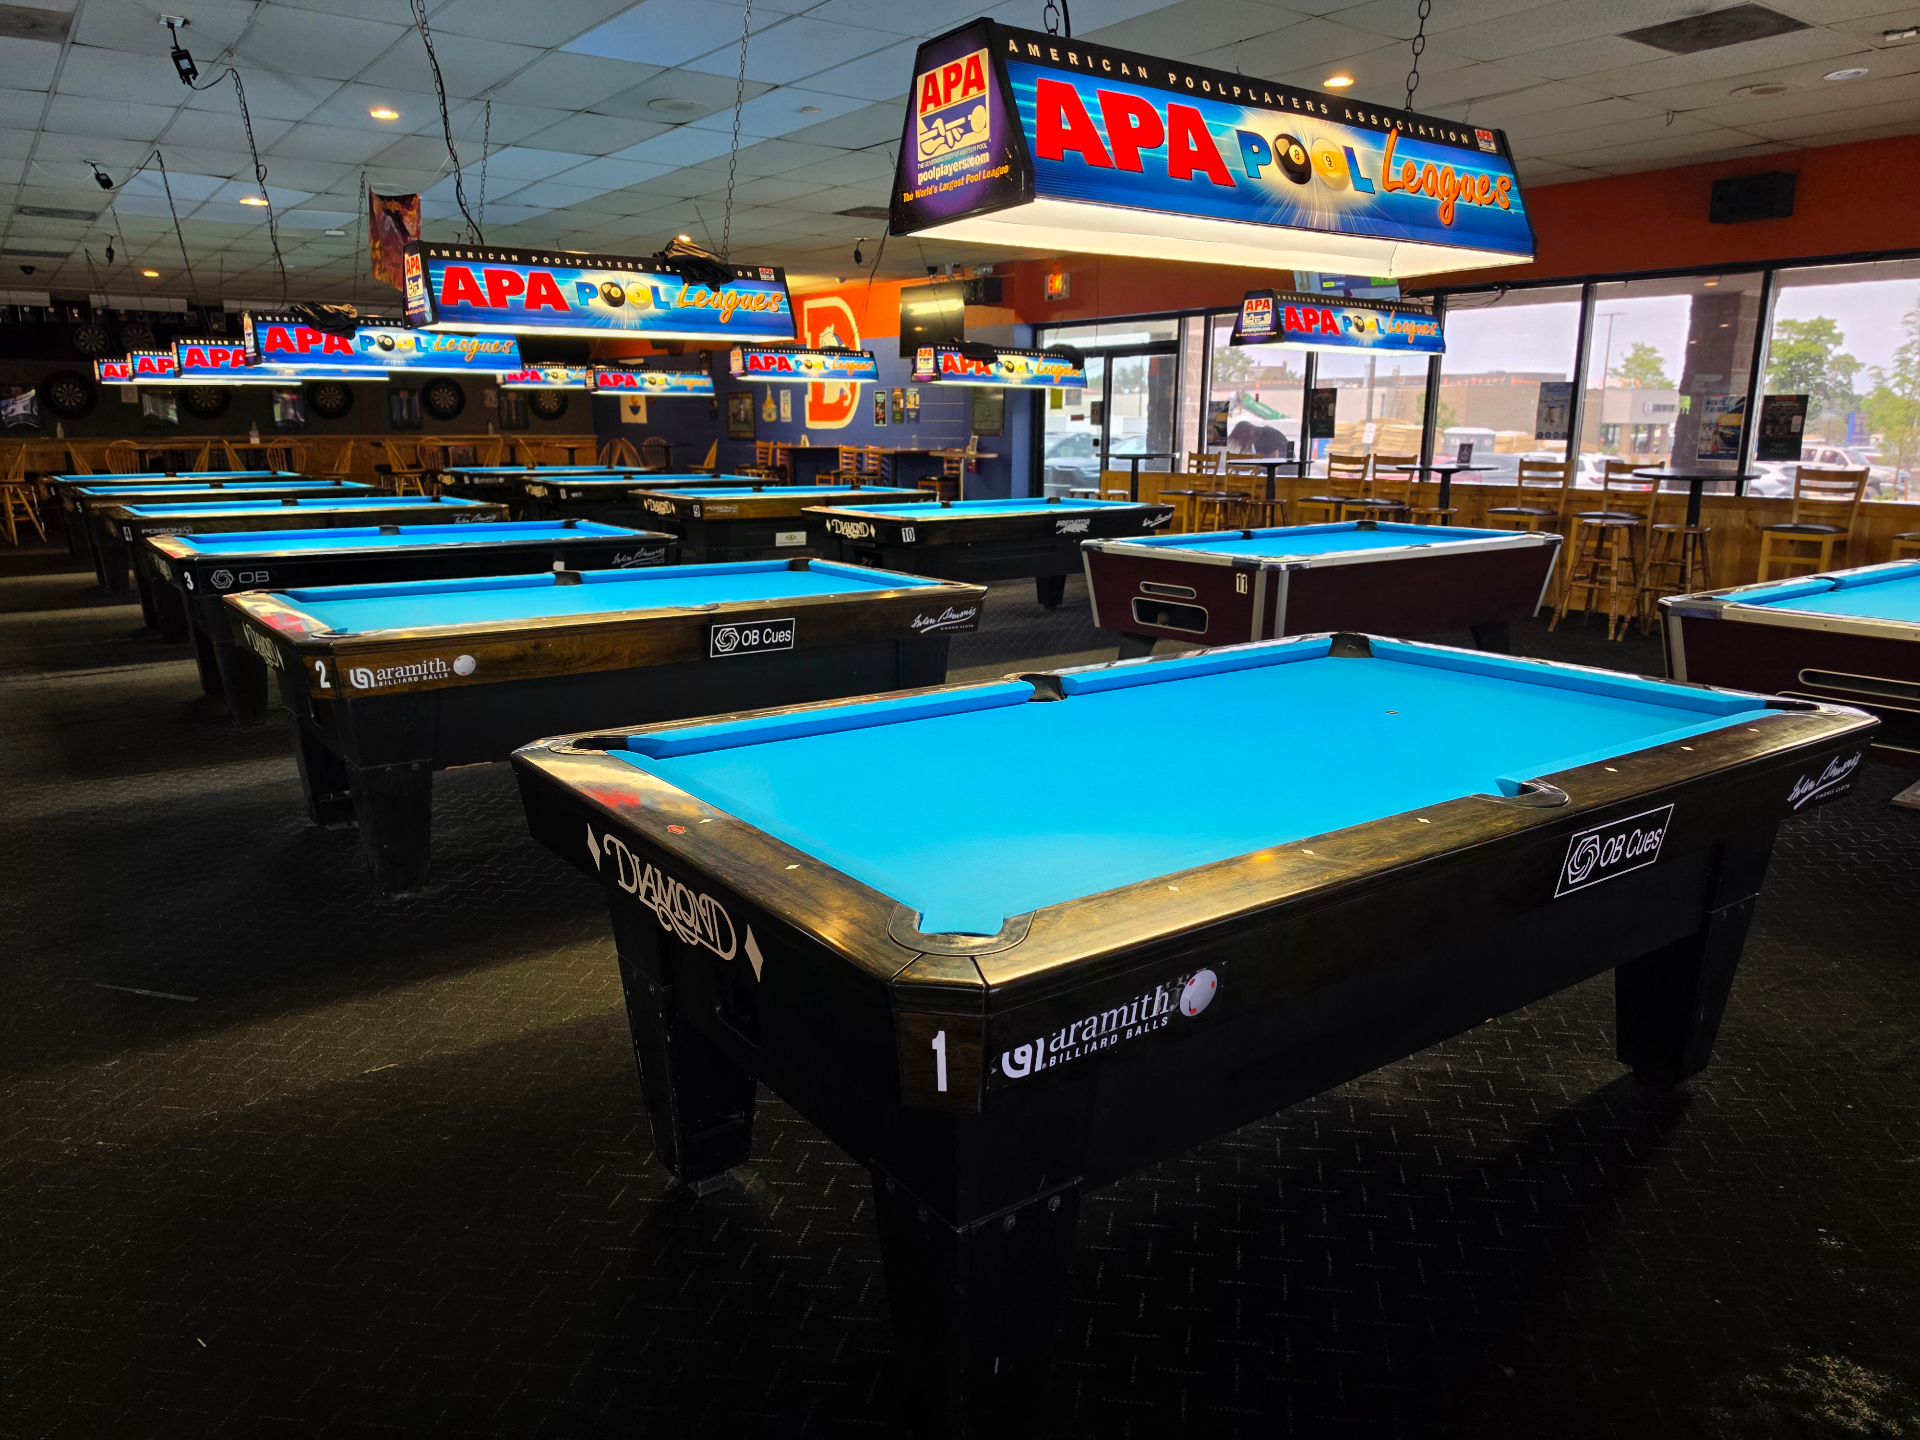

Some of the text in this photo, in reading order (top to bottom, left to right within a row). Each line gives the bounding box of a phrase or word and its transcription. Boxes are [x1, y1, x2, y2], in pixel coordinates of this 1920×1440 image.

[919, 54, 986, 114] APA
[1008, 39, 1468, 144] AMERICAN POOLPLAYERS ASSOCIATION
[1035, 77, 1236, 187] APA
[1382, 128, 1511, 225] Leagues
[917, 152, 989, 185] poolplayers.com
[903, 165, 1009, 202] The World's Largest Pool League
[406, 255, 420, 276] APA
[430, 249, 643, 270] AMERICAN POOLPLAYERS
[440, 266, 571, 311] APA
[678, 283, 783, 324] Leagues
[1245, 299, 1270, 311] APA
[258, 315, 303, 323] AMERIC
[1284, 306, 1341, 335] APA
[1388, 310, 1437, 344] Leagues
[263, 326, 355, 355] APA
[434, 334, 514, 362] Leagues
[918, 349, 932, 357] APA
[137, 357, 174, 373] AP
[748, 354, 793, 372] APA
[599, 373, 638, 387] APA
[831, 519, 869, 539] DIAMOND
[1056, 518, 1090, 527] PREDATOR
[902, 528, 914, 541] 10
[184, 571, 194, 590] 3
[238, 570, 270, 584] OB
[1236, 573, 1248, 594] 11
[742, 626, 791, 646] OB Cues
[315, 660, 331, 688] 2
[376, 658, 447, 680] aramith
[379, 677, 418, 687] BILLIARD
[1599, 828, 1663, 868] OB Cues
[603, 833, 737, 960] DIAMOND
[1049, 984, 1169, 1052] aramith
[1049, 1016, 1169, 1067] BILLIARD BALLS
[932, 1030, 948, 1092] 1
